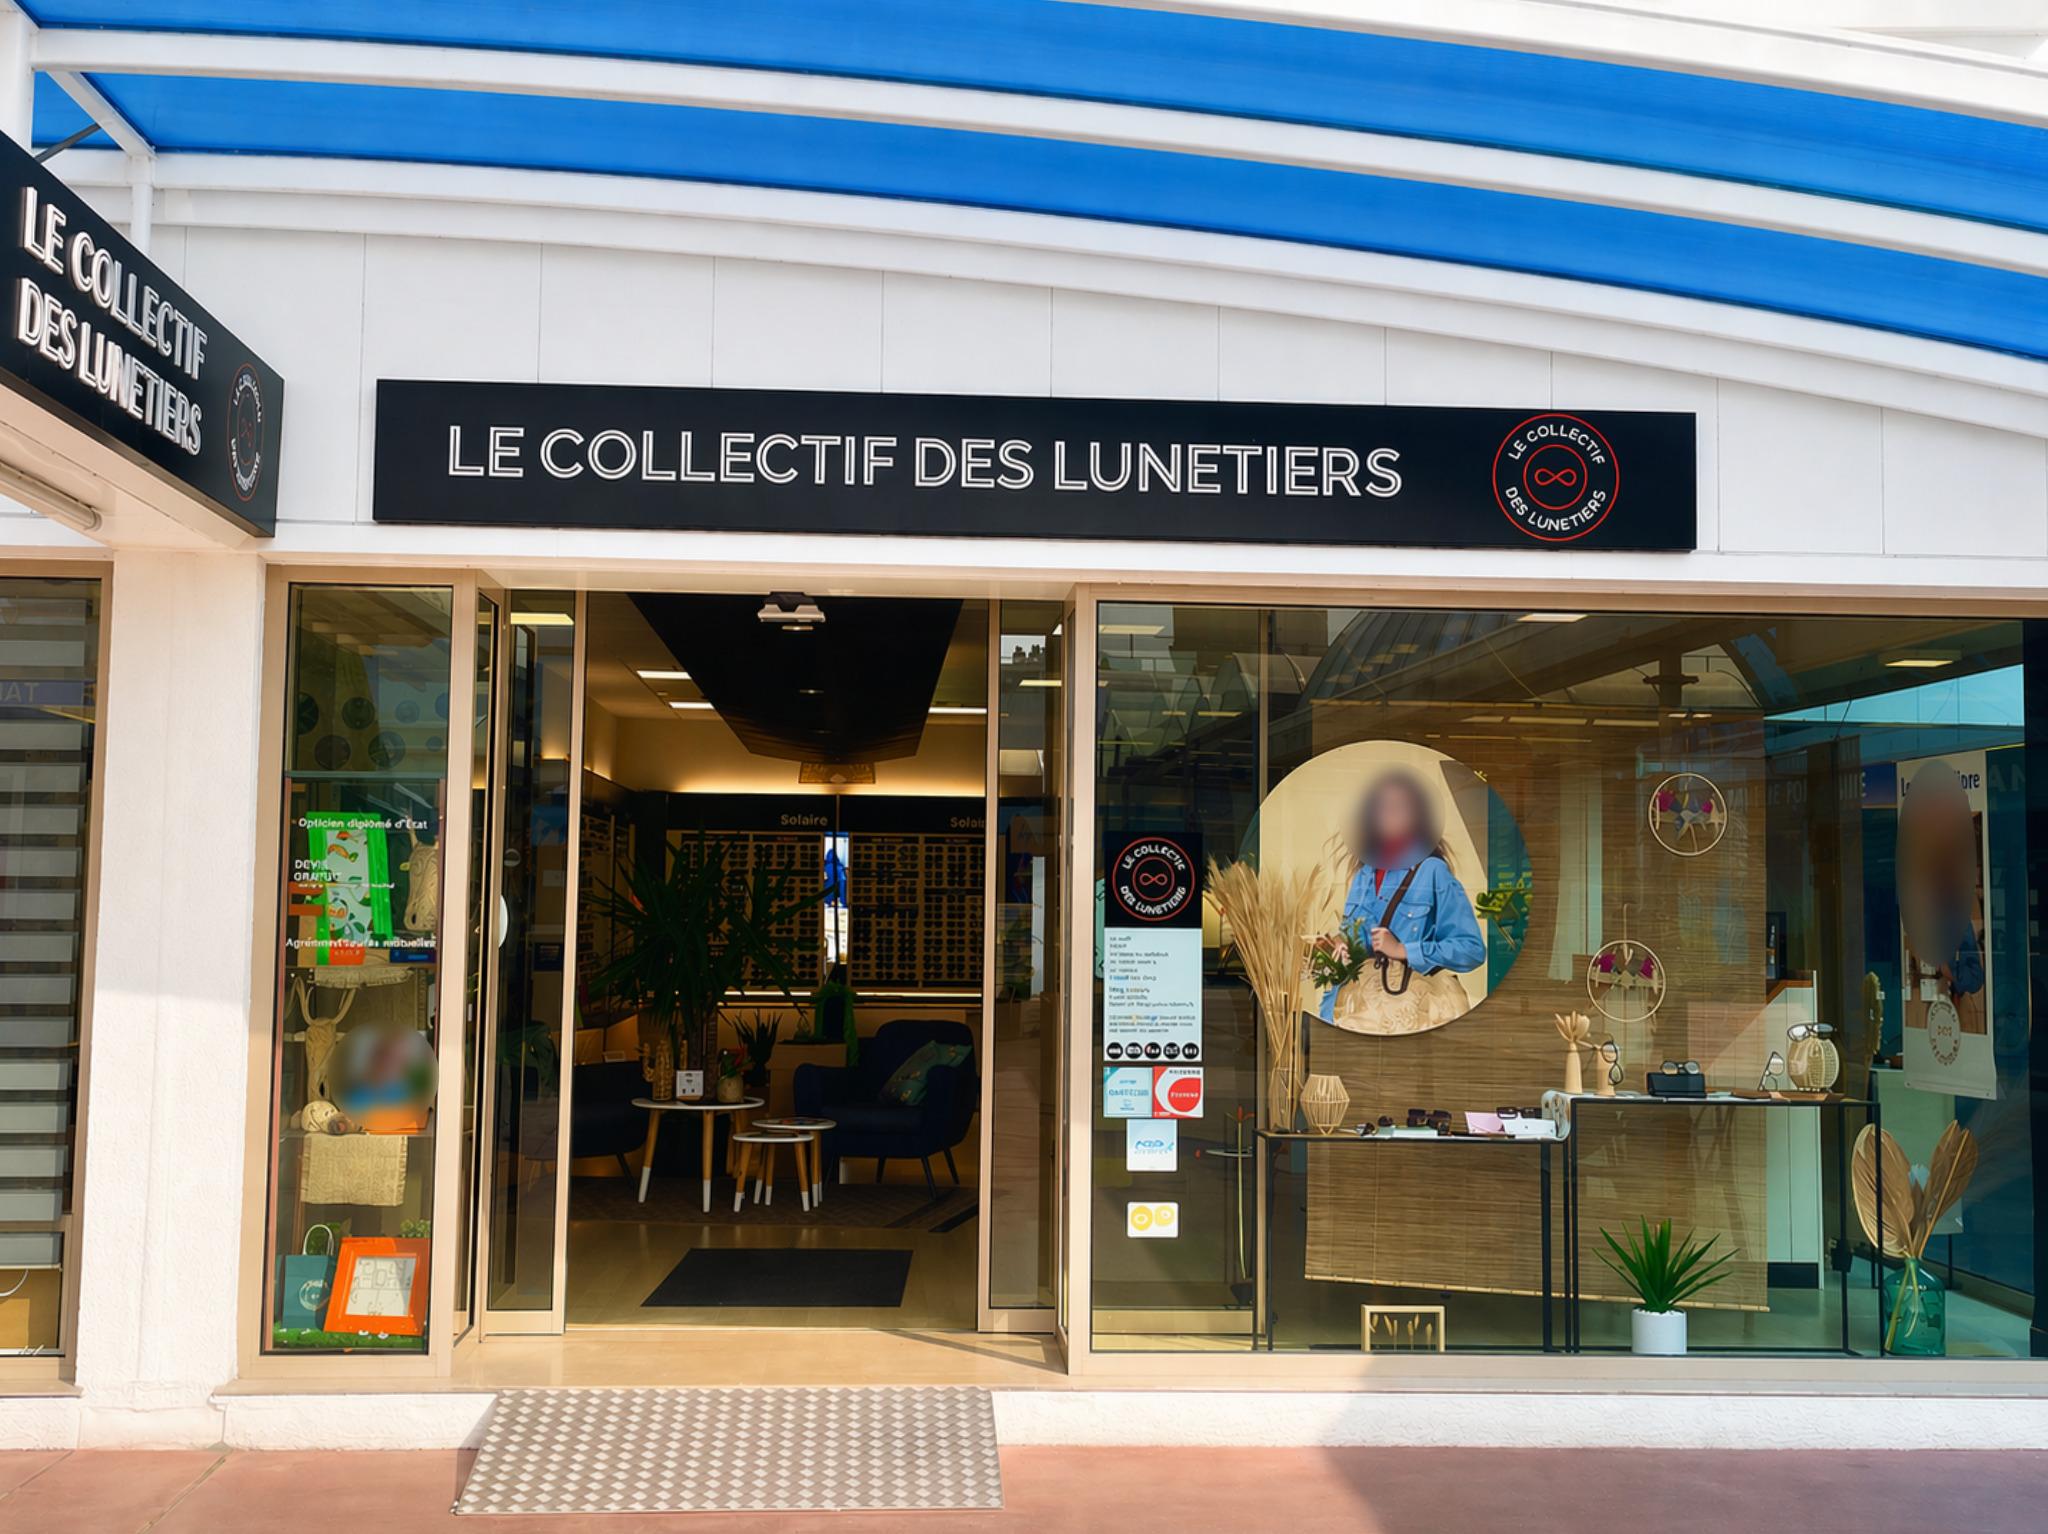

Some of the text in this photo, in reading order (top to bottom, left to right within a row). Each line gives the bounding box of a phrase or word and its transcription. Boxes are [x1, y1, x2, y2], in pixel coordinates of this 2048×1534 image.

[20, 187, 208, 380] LE COLLECTIF
[18, 277, 78, 370] DES
[78, 321, 202, 456] LUNETIERS
[449, 425, 1402, 498] LE COLLECTIF DES LUNETIERS
[1508, 424, 1606, 465] LE COLLECTIF
[1505, 486, 1606, 531] DES LUNETIERS
[298, 817, 344, 829] Opticien
[781, 814, 828, 826] Solaire
